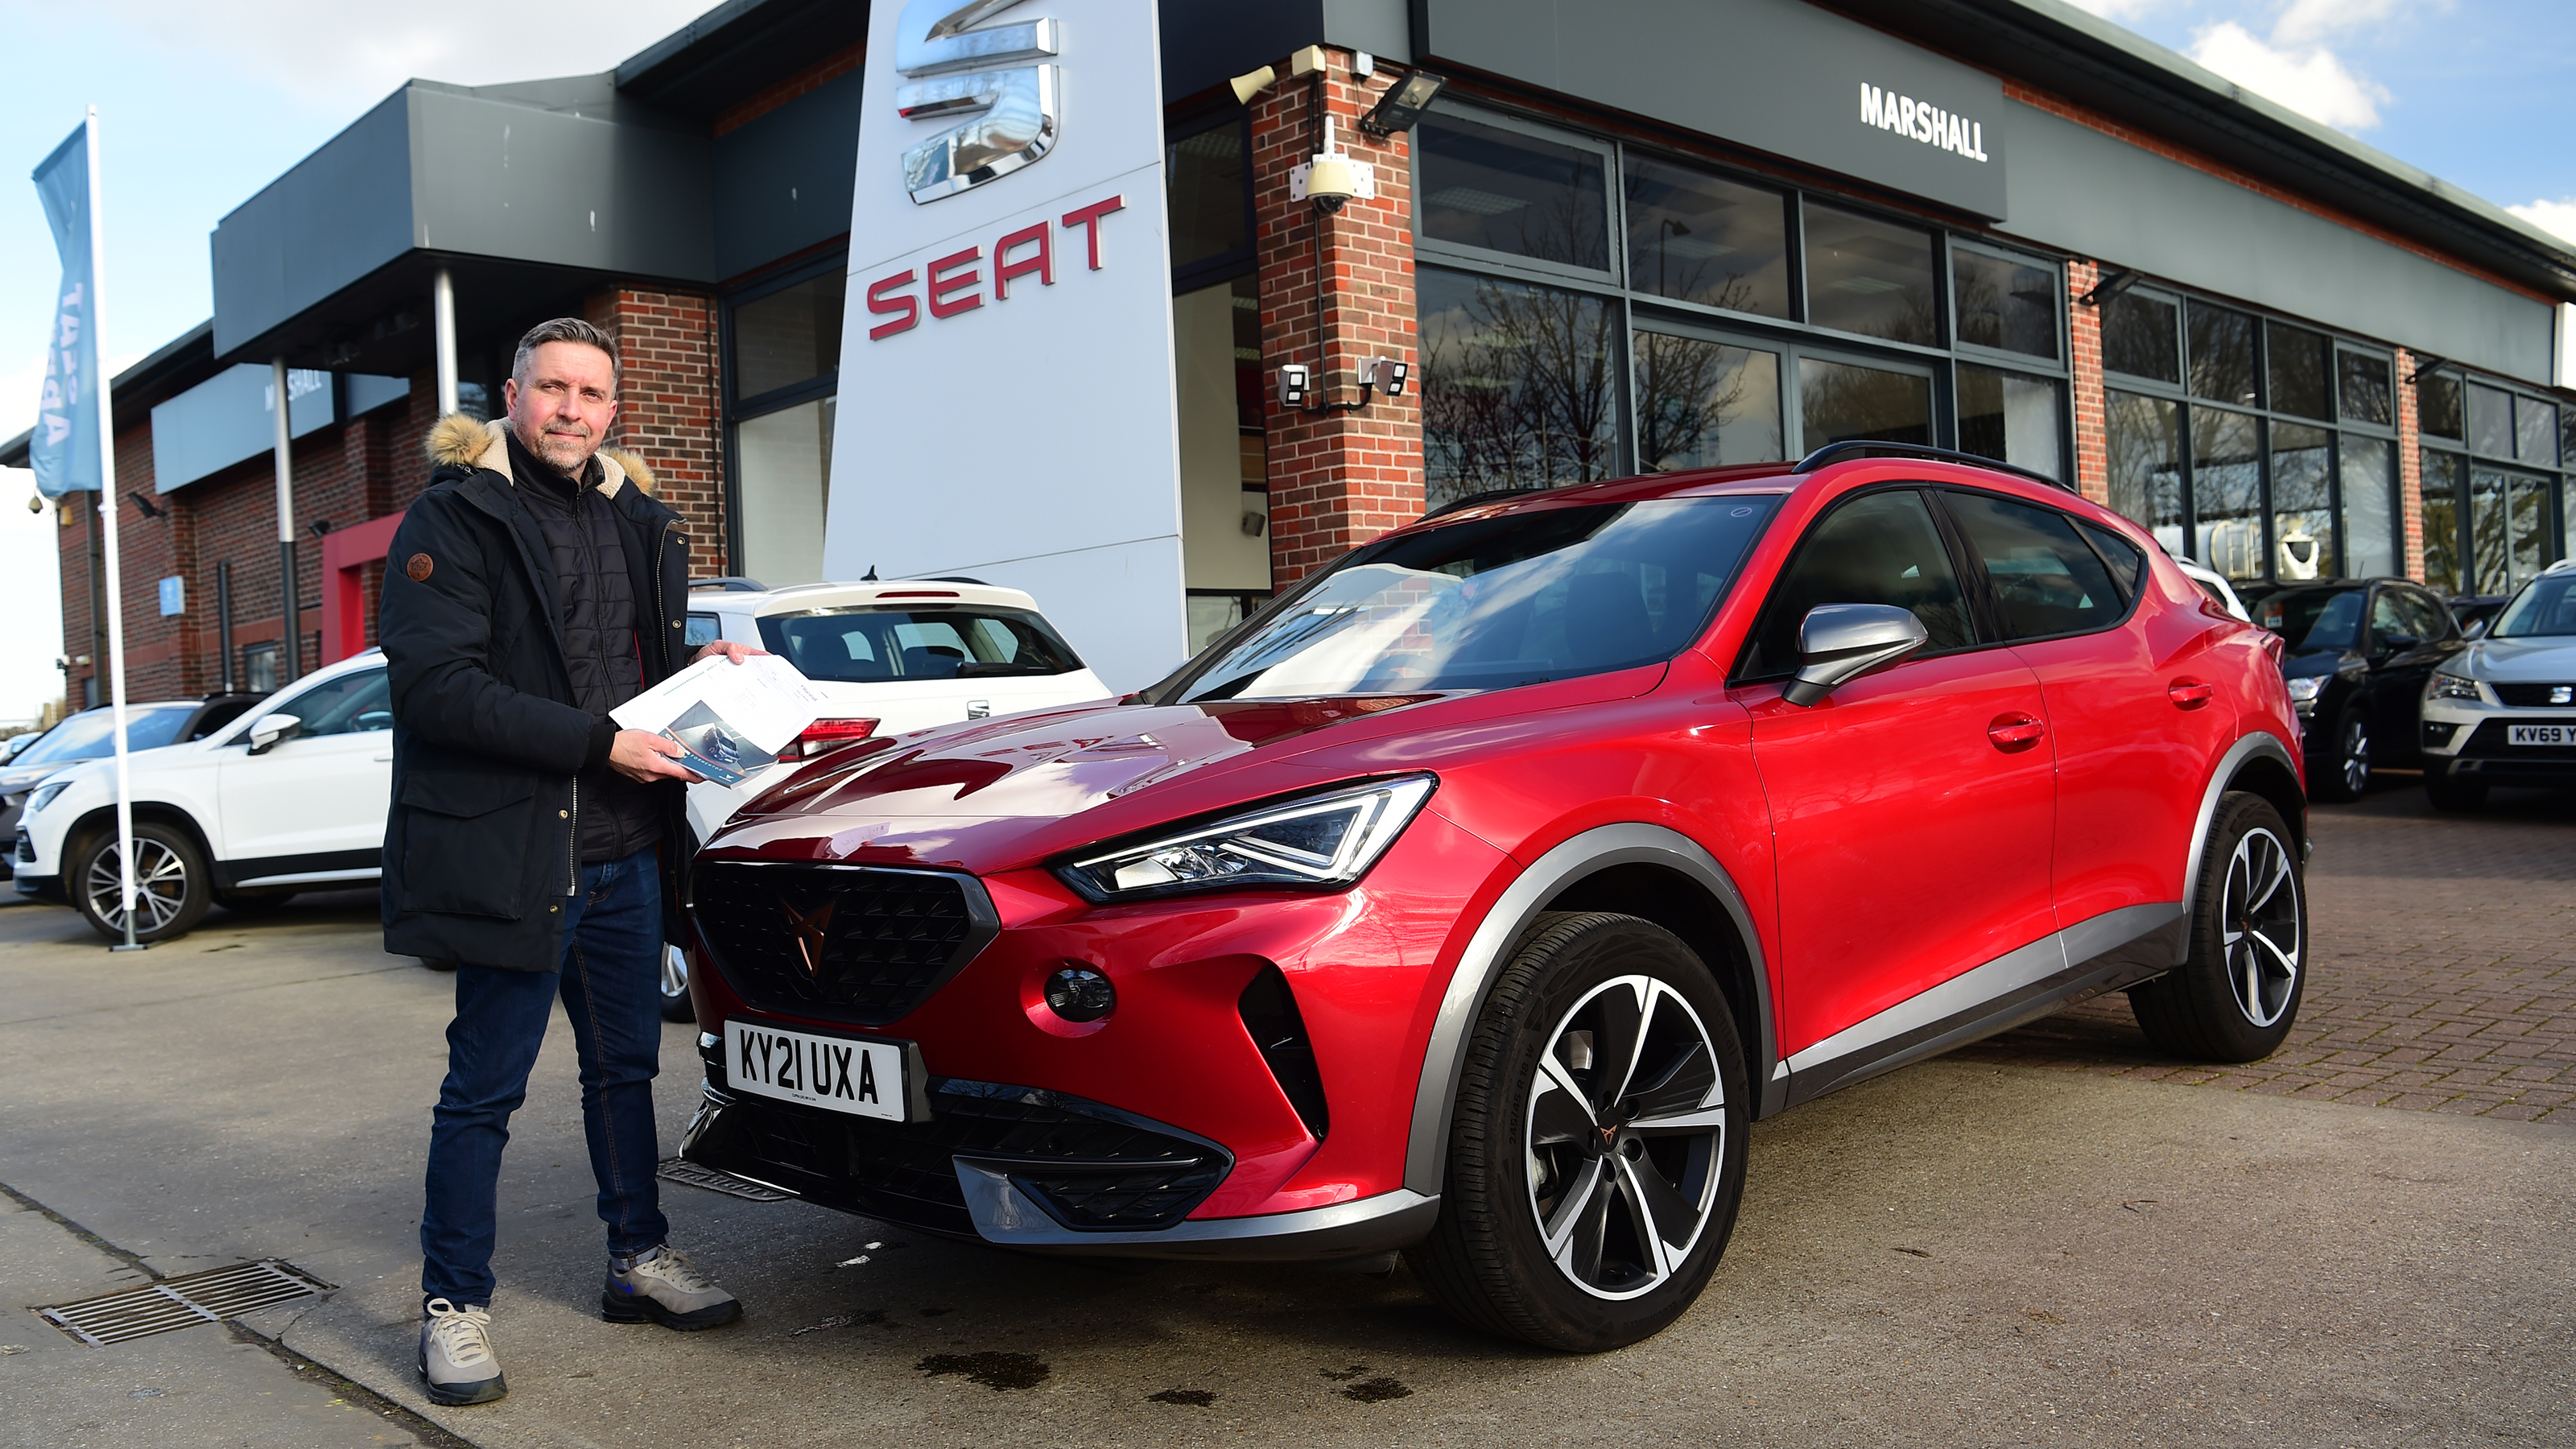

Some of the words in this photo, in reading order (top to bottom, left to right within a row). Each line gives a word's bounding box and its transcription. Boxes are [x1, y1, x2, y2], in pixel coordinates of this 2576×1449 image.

[1860, 81, 1988, 163] MARSHALL
[867, 194, 1126, 341] SEAT
[690, 754, 723, 771] FORMENTOR
[2516, 728, 2562, 742] KV69
[740, 1029, 803, 1091] KY21
[810, 1042, 879, 1104] UXA
[1509, 1093, 1521, 1145] 245/45
